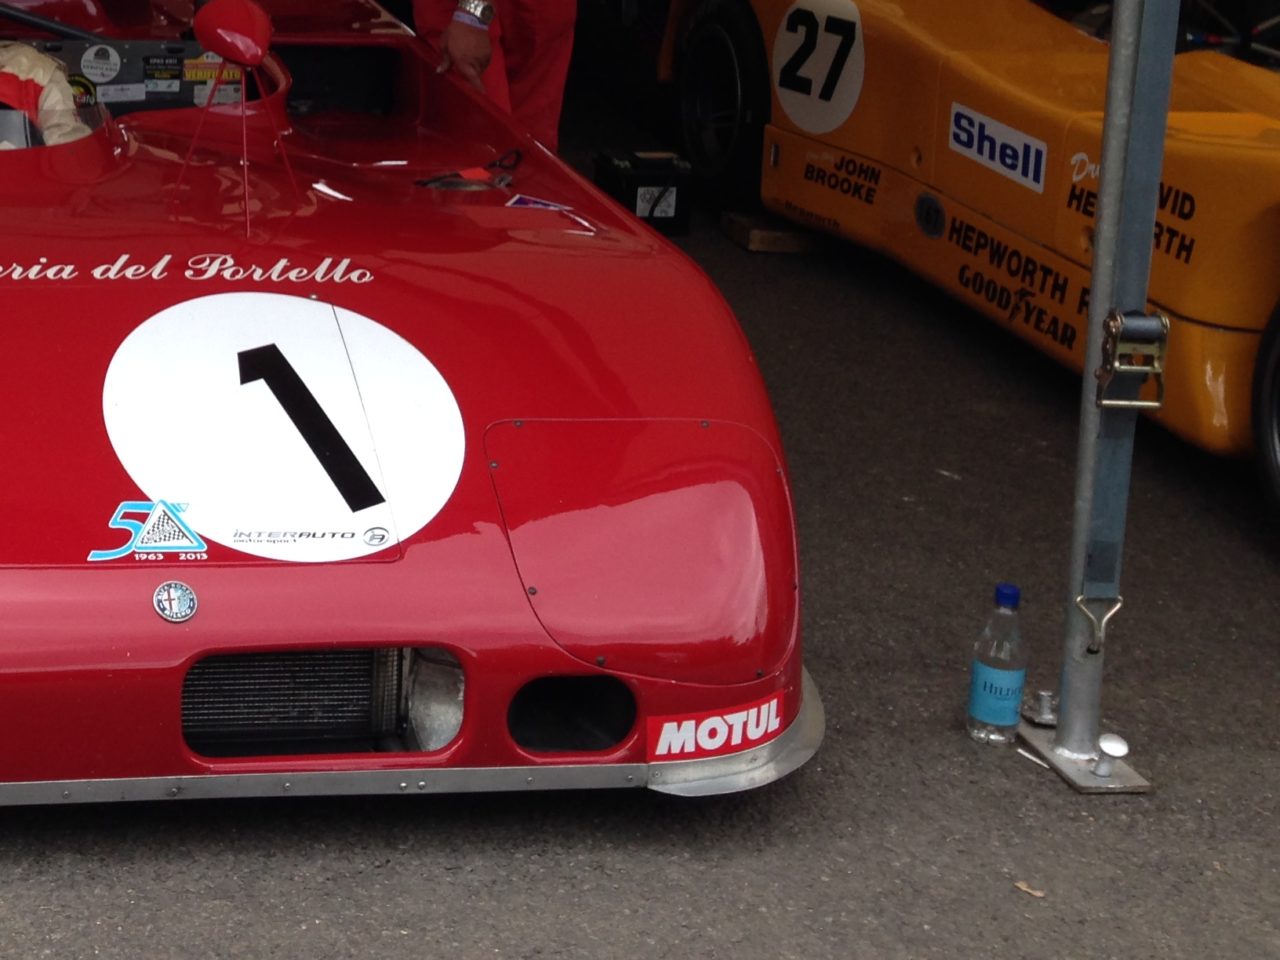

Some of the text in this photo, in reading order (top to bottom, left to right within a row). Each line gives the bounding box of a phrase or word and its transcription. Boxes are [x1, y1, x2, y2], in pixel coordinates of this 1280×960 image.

[778, 8, 857, 103] 27
[833, 155, 882, 186] JOHN
[952, 111, 1044, 185] Shell
[803, 163, 878, 206] BROOKE
[91, 253, 173, 280] del
[184, 253, 375, 284] Portello
[948, 217, 1070, 305] HEPWORTH
[958, 264, 1078, 351] GOODYEAR
[236, 343, 386, 513] 1
[134, 552, 209, 561] 1963 2013
[655, 698, 781, 756] MOTUL
